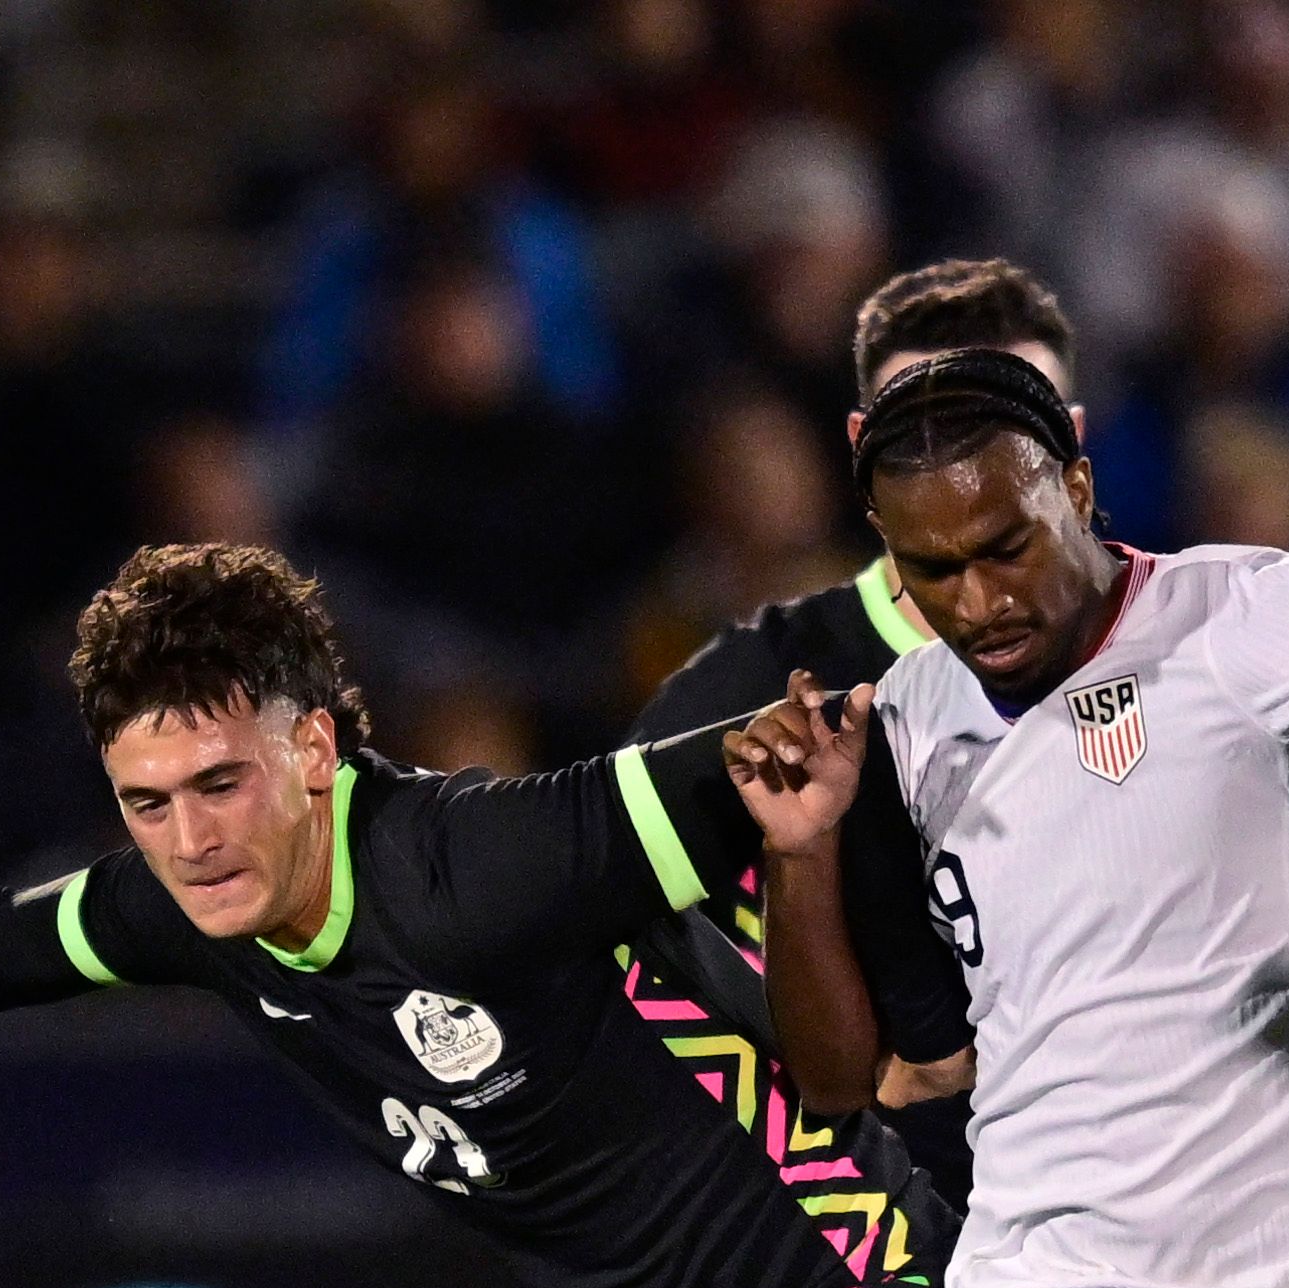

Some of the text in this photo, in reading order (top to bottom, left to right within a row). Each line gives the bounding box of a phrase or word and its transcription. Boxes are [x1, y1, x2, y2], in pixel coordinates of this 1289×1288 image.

[1073, 682, 1134, 724] USA
[929, 849, 984, 968] 9
[431, 1036, 485, 1063] AUSTRALIA
